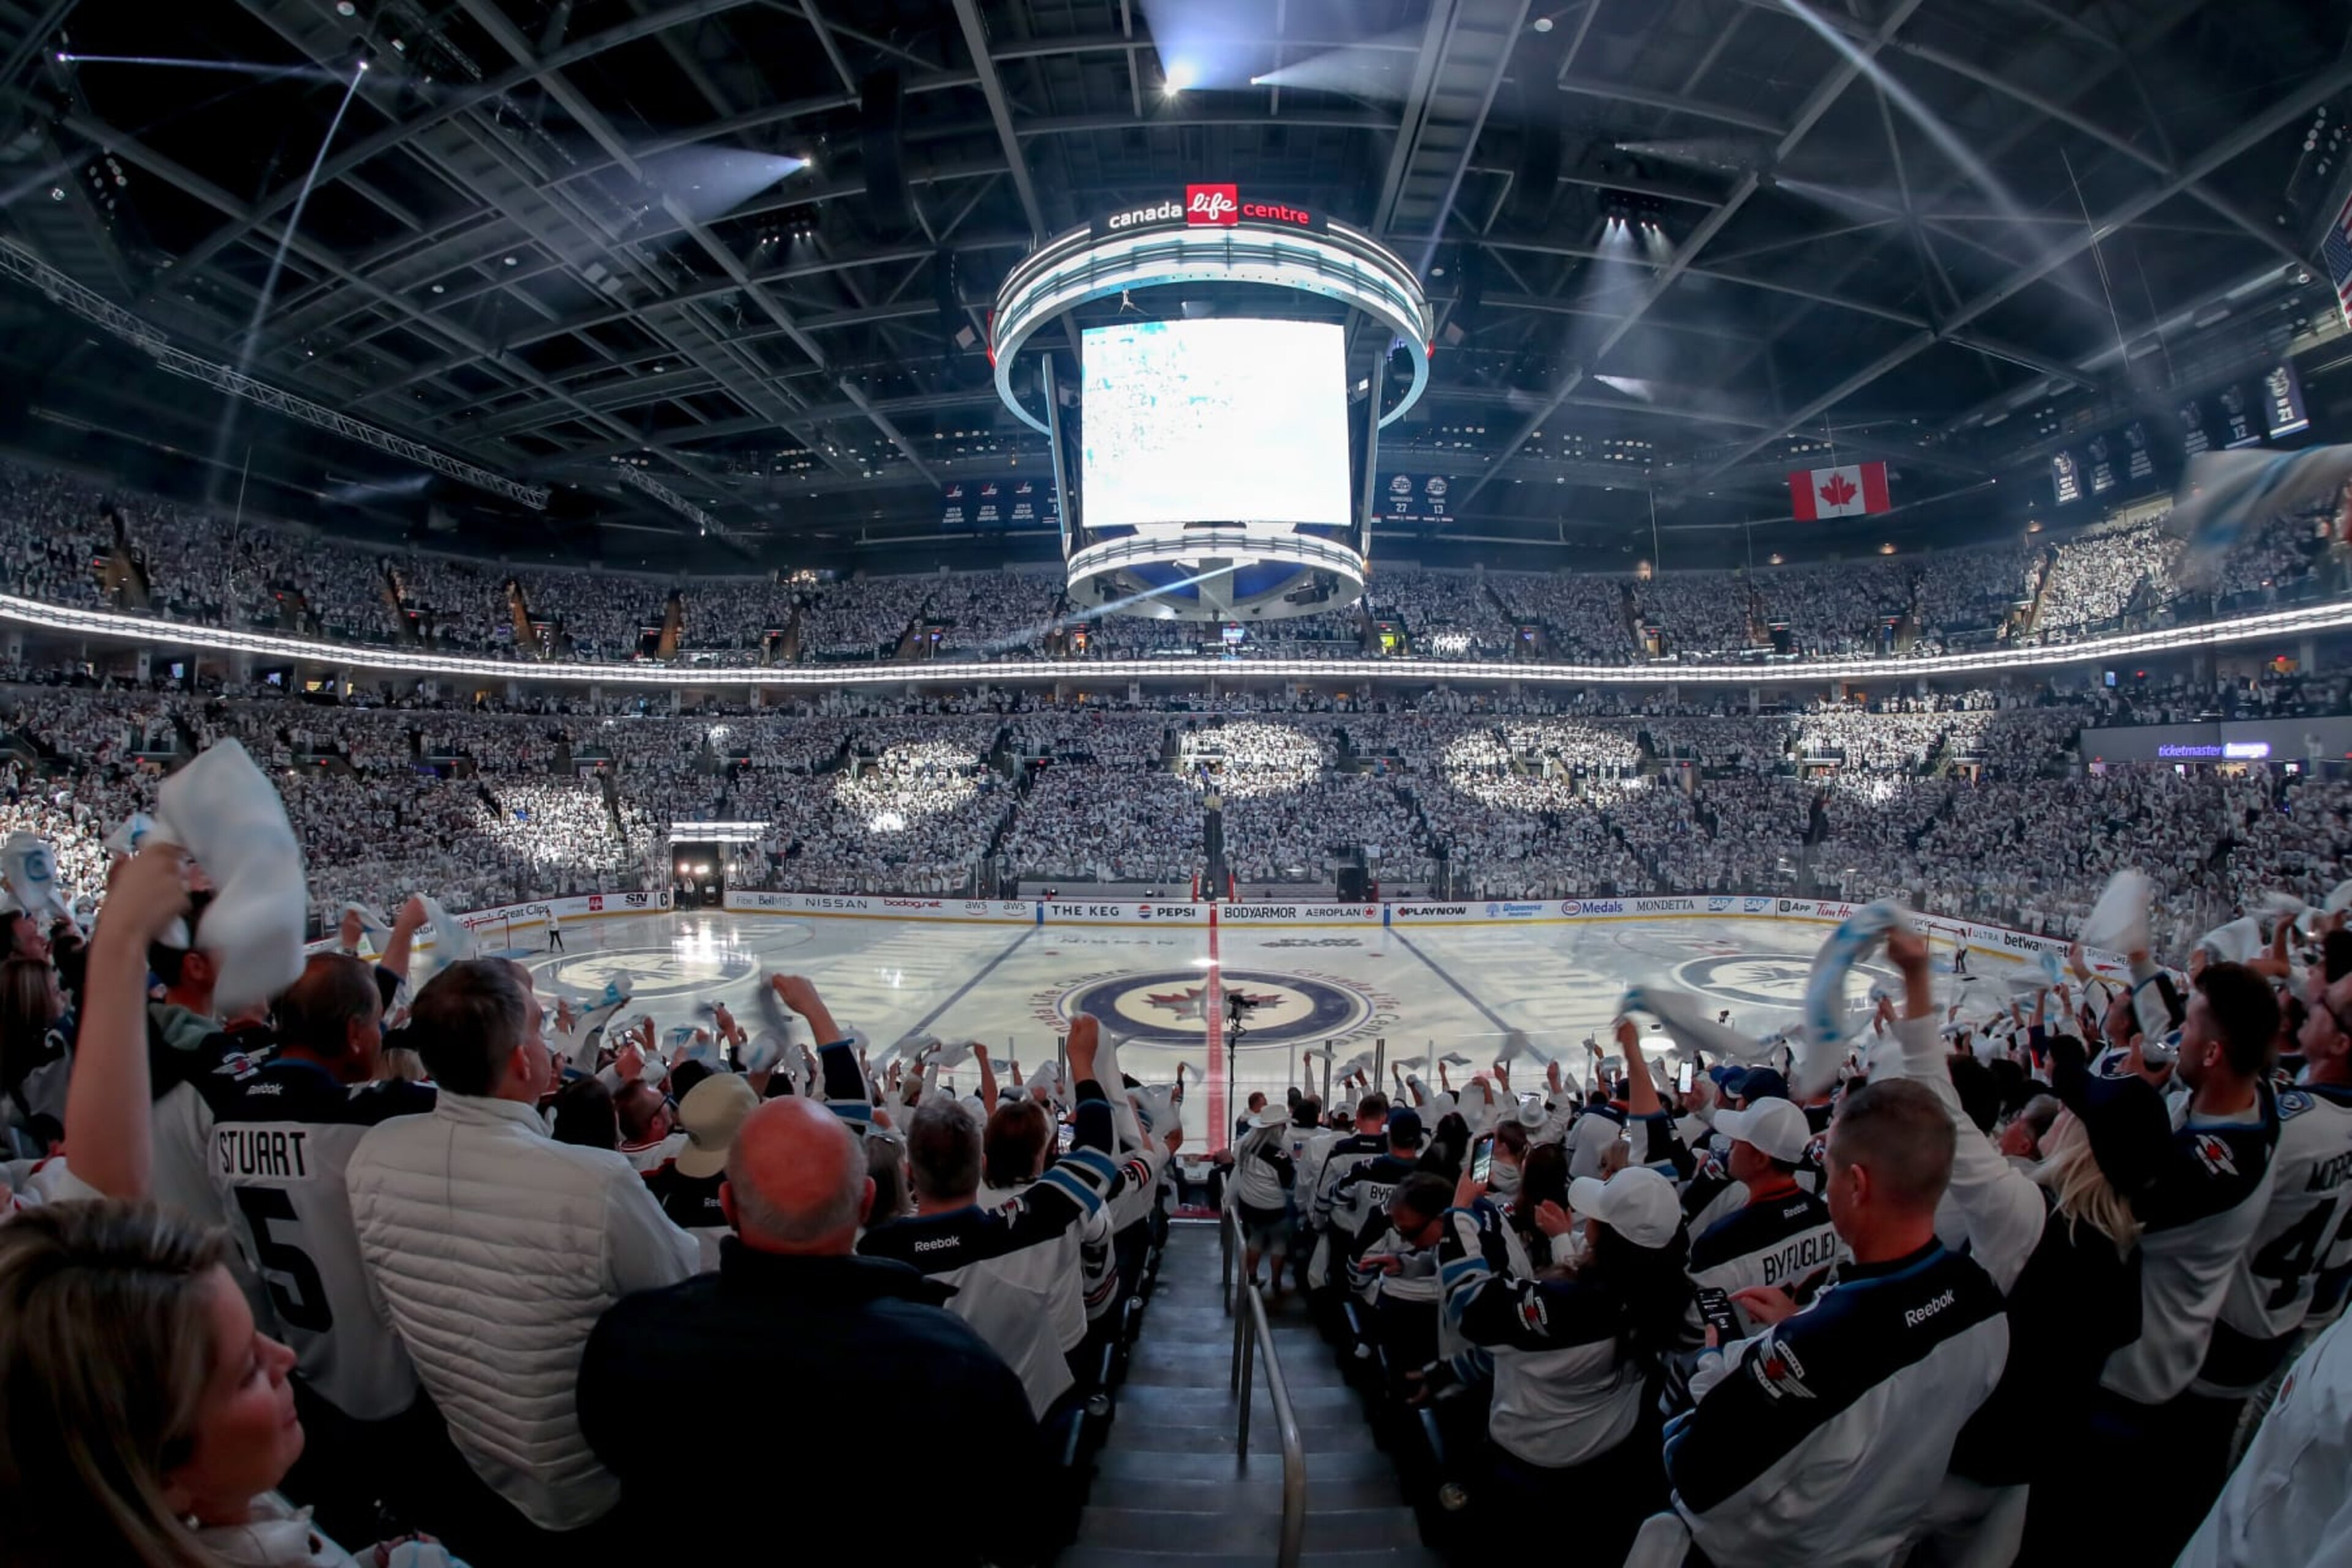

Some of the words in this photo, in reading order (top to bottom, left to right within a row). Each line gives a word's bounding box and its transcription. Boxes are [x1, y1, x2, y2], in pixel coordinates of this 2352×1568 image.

[1109, 202, 1183, 228] canada
[1187, 192, 1238, 220] life
[1243, 203, 1309, 224] centre
[2158, 744, 2222, 757] ticketmaster
[626, 894, 647, 902] SN
[805, 898, 867, 909] NISSAN
[884, 899, 942, 909] bodog.net
[1003, 902, 1026, 910] aws
[1583, 901, 1623, 913] Medals
[1637, 899, 1694, 911] MONDETTA
[1708, 900, 1728, 910] SAP
[1745, 899, 1765, 910] SAP
[1817, 902, 1836, 916] Tim
[497, 909, 524, 919] Great
[526, 904, 550, 916] Clips
[1052, 905, 1082, 916] THE
[1089, 906, 1120, 916] KEG
[1157, 908, 1196, 917] PEPSI
[1224, 907, 1297, 918] BODYARMOR
[1305, 908, 1361, 917] AEROPLAN
[1406, 907, 1466, 916] PLAYNOW
[1972, 930, 1999, 942] ULTRA
[219, 1131, 306, 1177] STUART
[914, 1235, 960, 1253] Reebok
[234, 1186, 333, 1333] 5
[1904, 1287, 1956, 1329] Reebok
